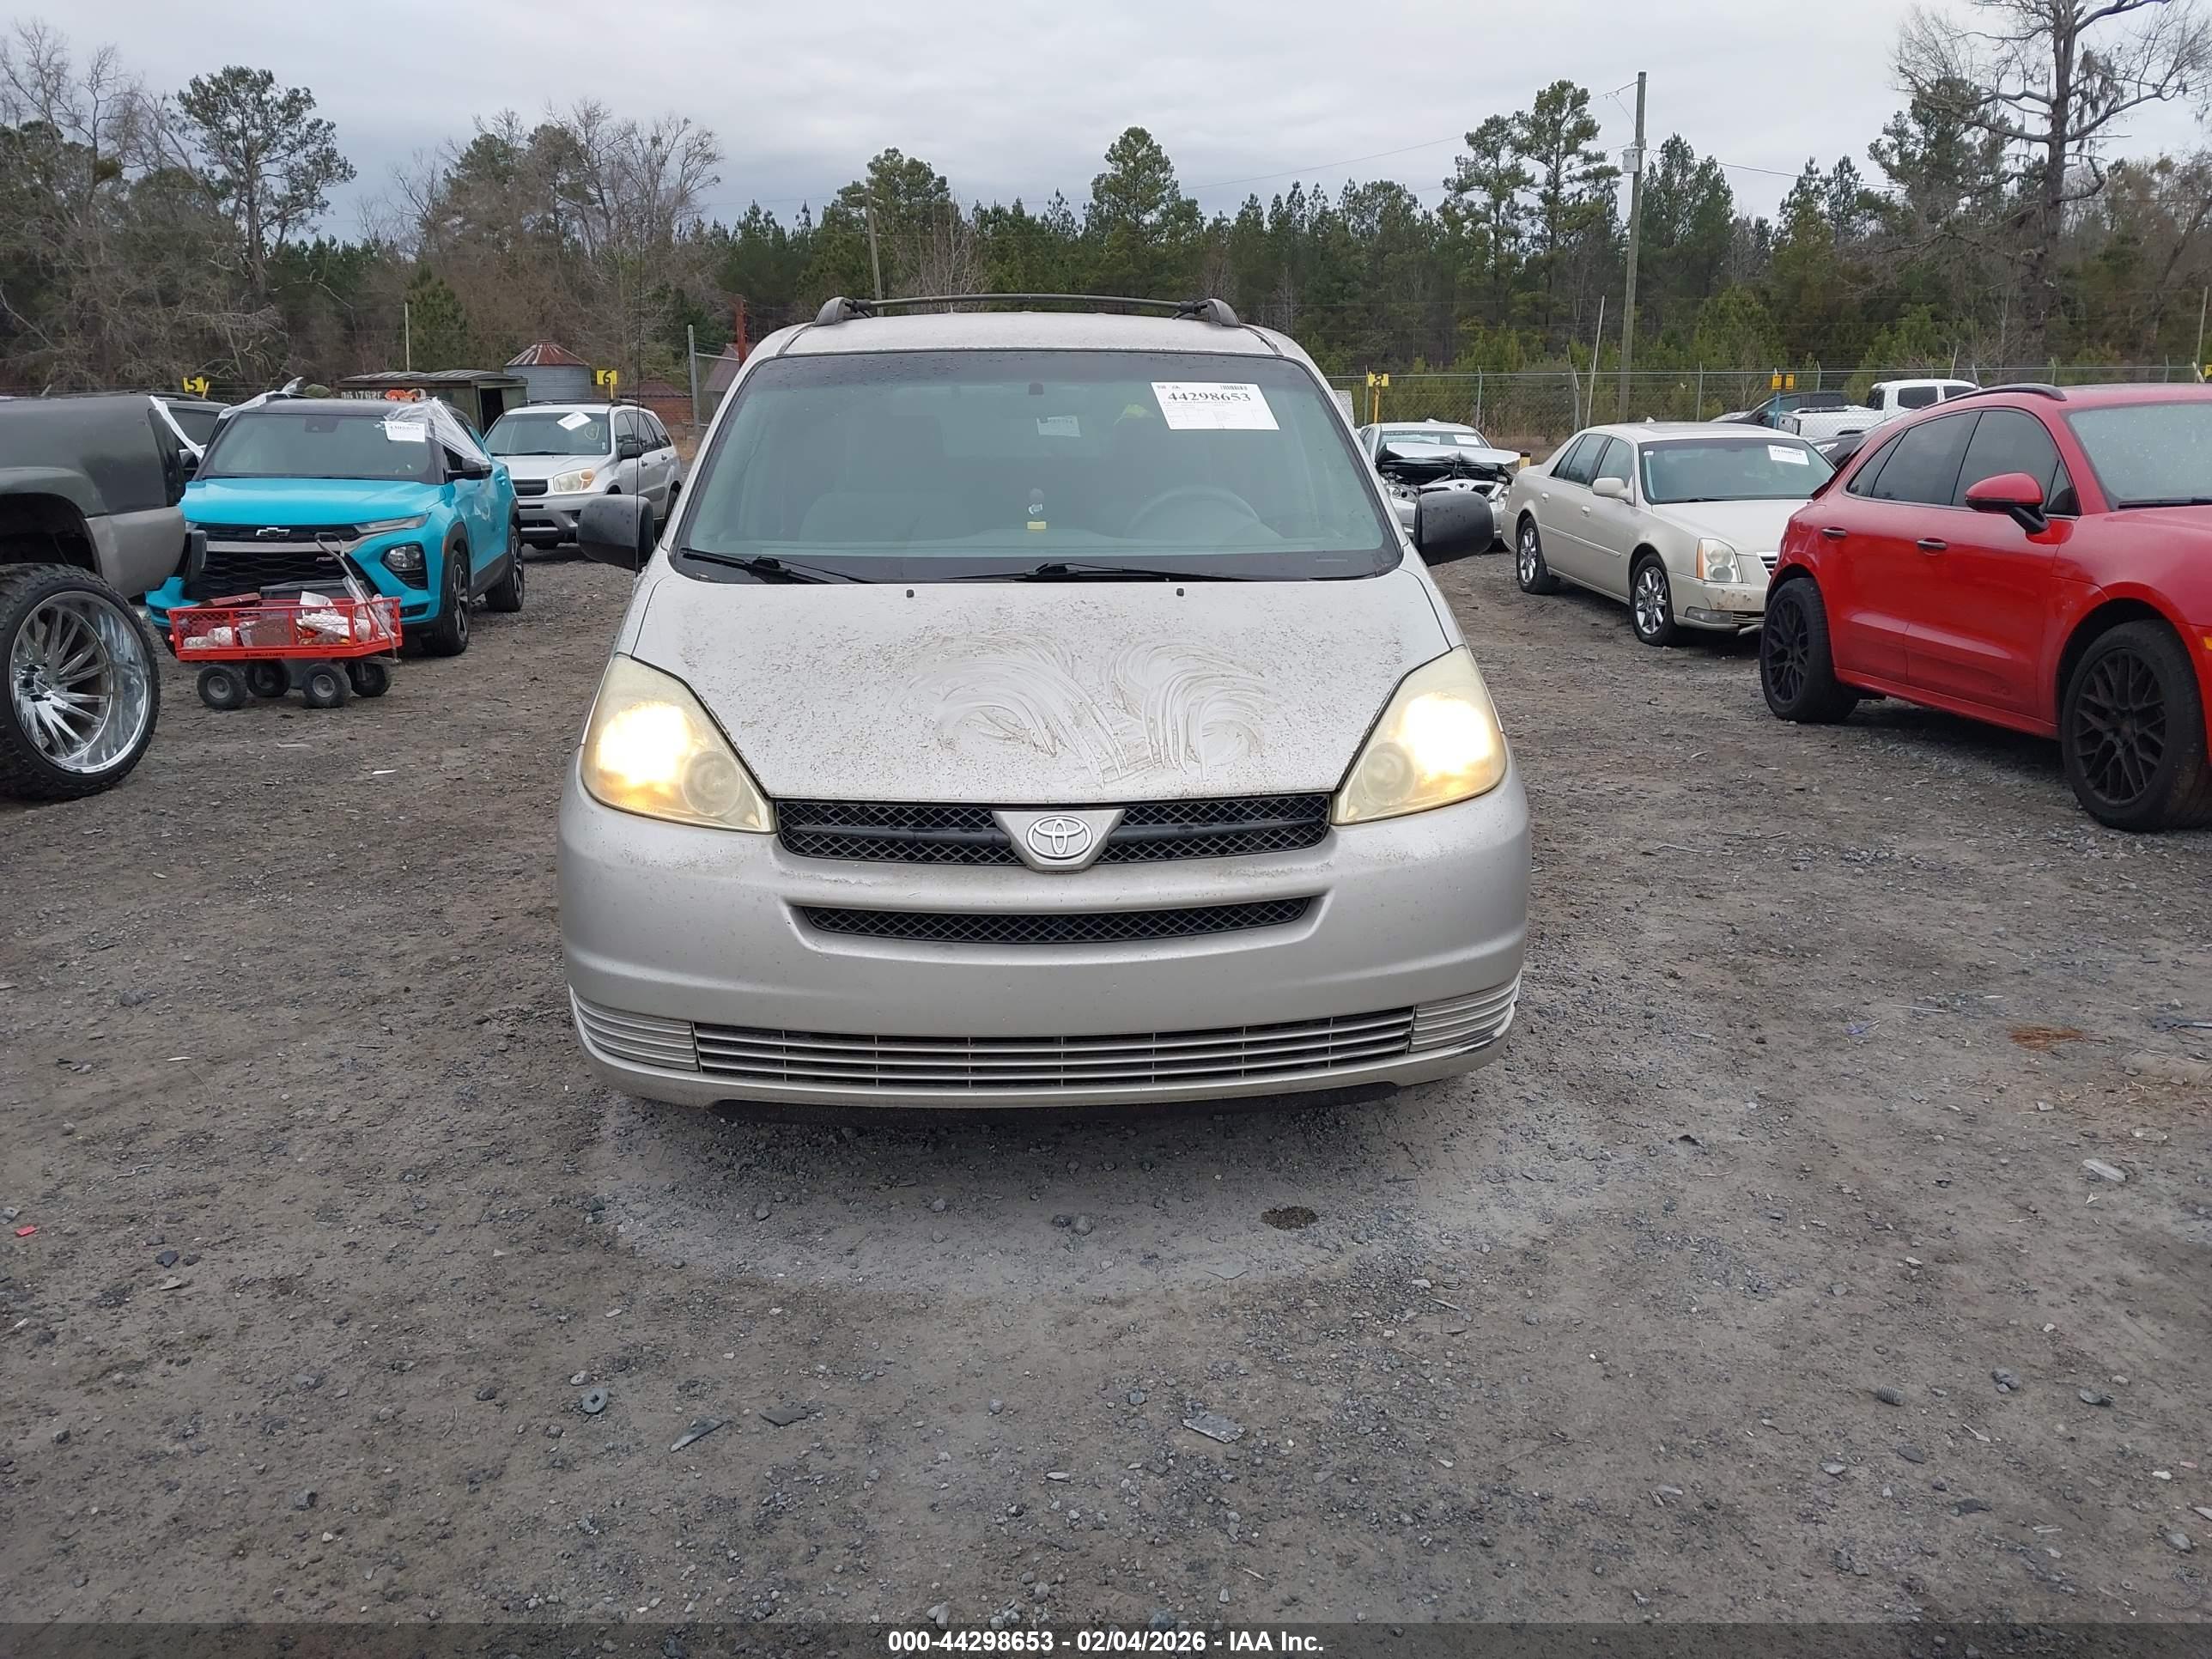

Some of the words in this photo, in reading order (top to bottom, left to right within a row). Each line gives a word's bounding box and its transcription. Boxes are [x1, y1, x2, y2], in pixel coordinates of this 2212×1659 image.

[186, 377, 198, 391] 5
[603, 370, 611, 384] 6
[1168, 392, 1251, 402] 44298653
